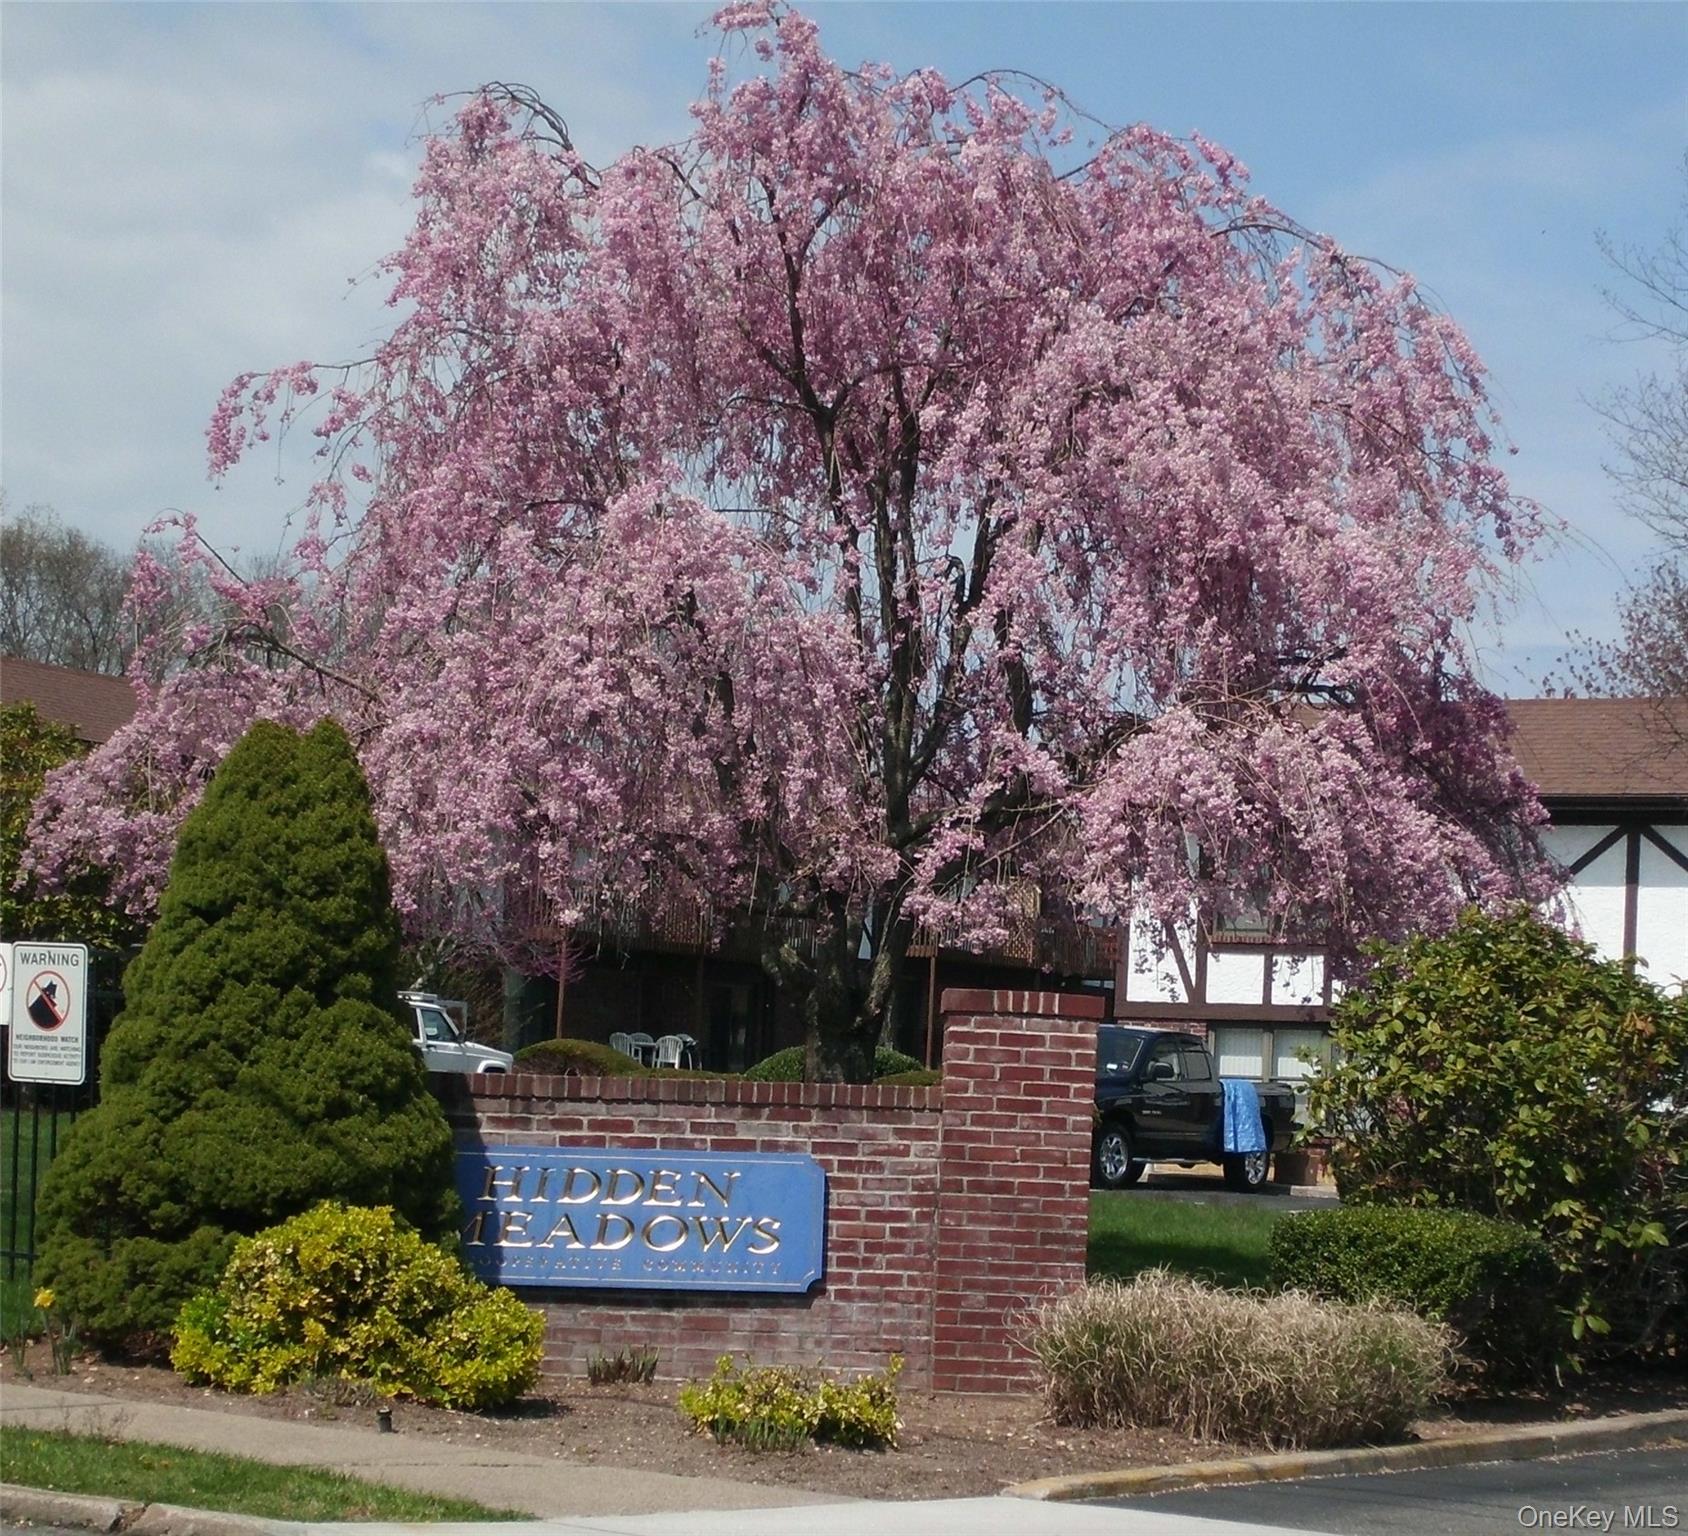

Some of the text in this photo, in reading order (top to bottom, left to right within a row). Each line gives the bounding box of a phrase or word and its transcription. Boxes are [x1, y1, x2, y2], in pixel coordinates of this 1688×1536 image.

[20, 952, 79, 966] WARNING
[477, 1165, 741, 1208] HIDDEN
[477, 1255, 782, 1276] OOPERATIVE COMMUNITY
